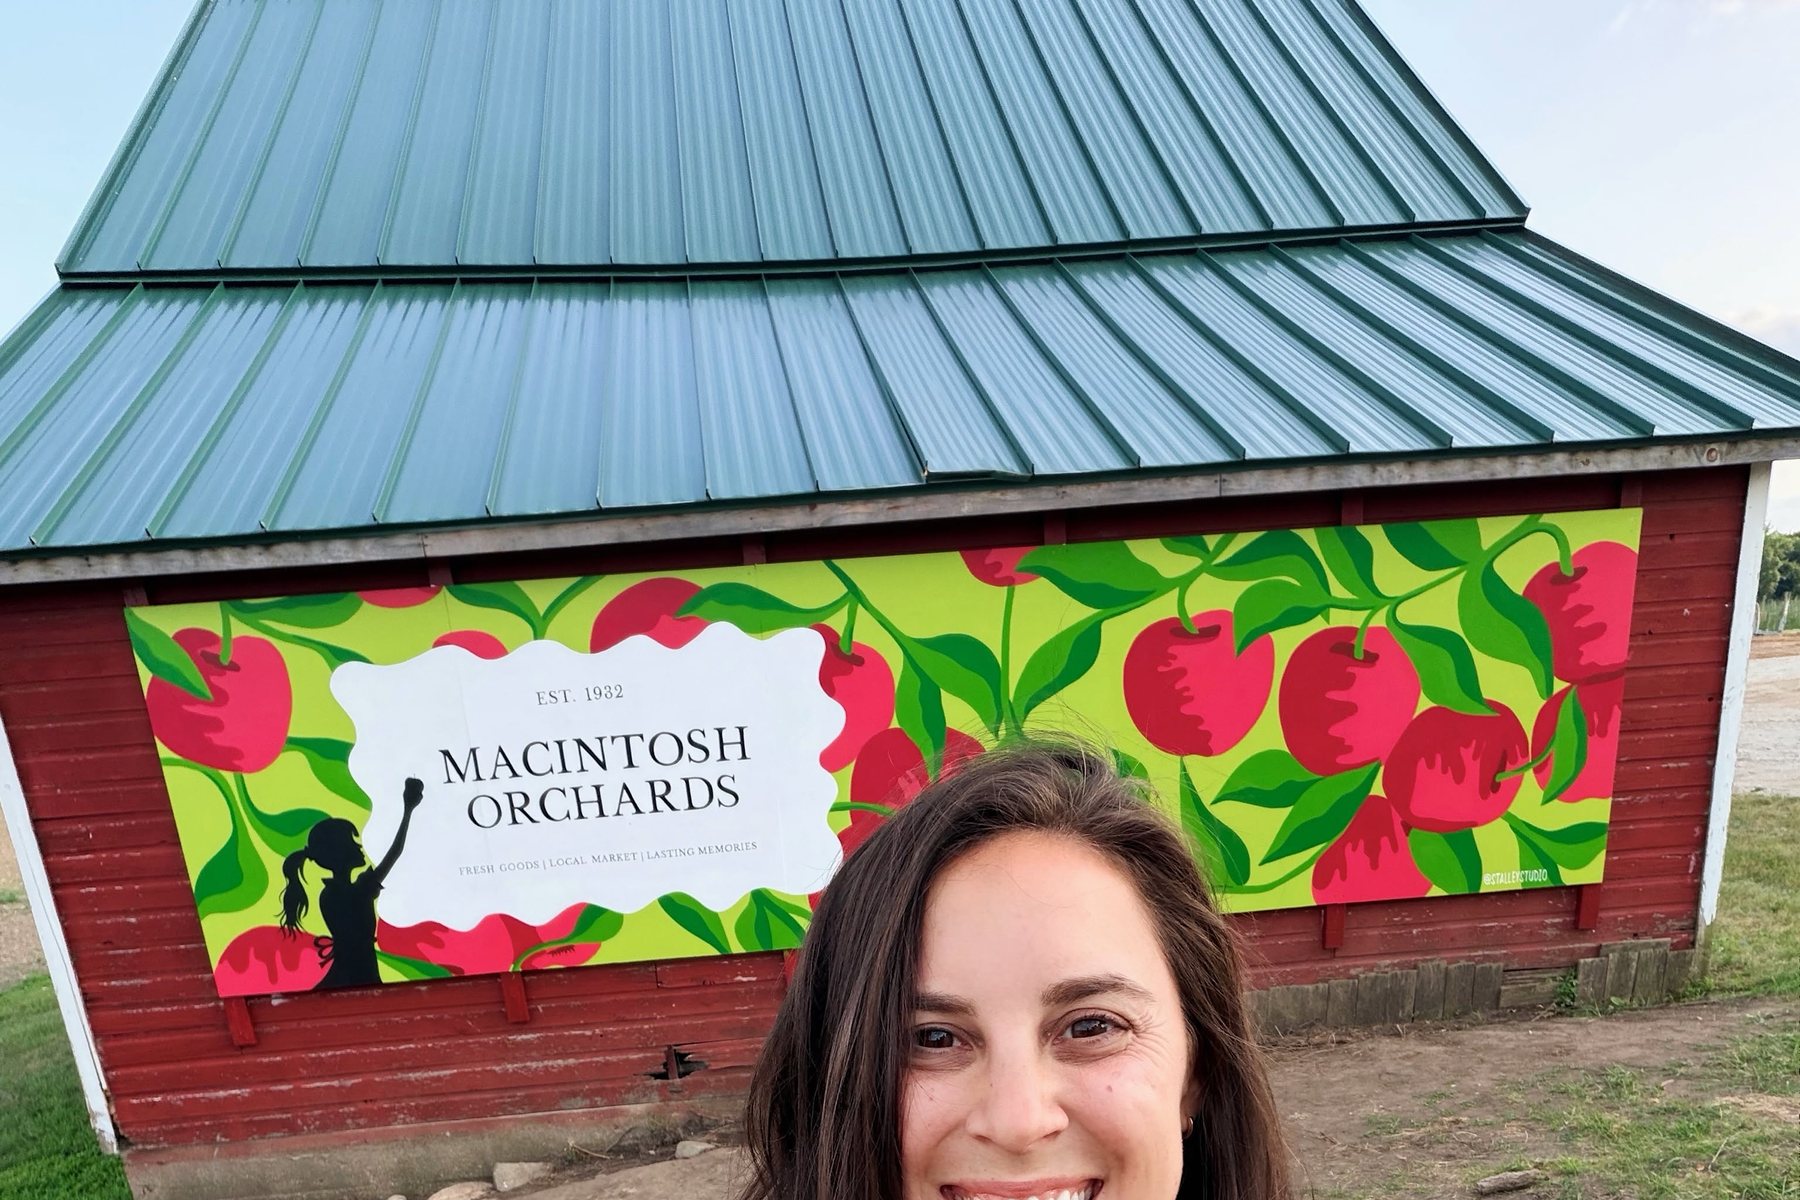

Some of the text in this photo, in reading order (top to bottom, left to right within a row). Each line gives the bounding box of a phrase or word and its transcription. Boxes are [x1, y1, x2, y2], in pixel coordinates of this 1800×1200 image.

[536, 684, 624, 705] EST. 1932
[438, 726, 752, 785] MACINTOSH
[467, 774, 741, 829] ORCHARDS
[458, 864, 495, 876] FRESH
[499, 860, 540, 872] GOODS
[549, 856, 588, 868] LOCAL
[591, 852, 638, 864] MARKET
[646, 847, 695, 860] LASTING
[697, 841, 758, 856] MEMORIES
[1483, 869, 1548, 885] @STALLEYSTUDIO
